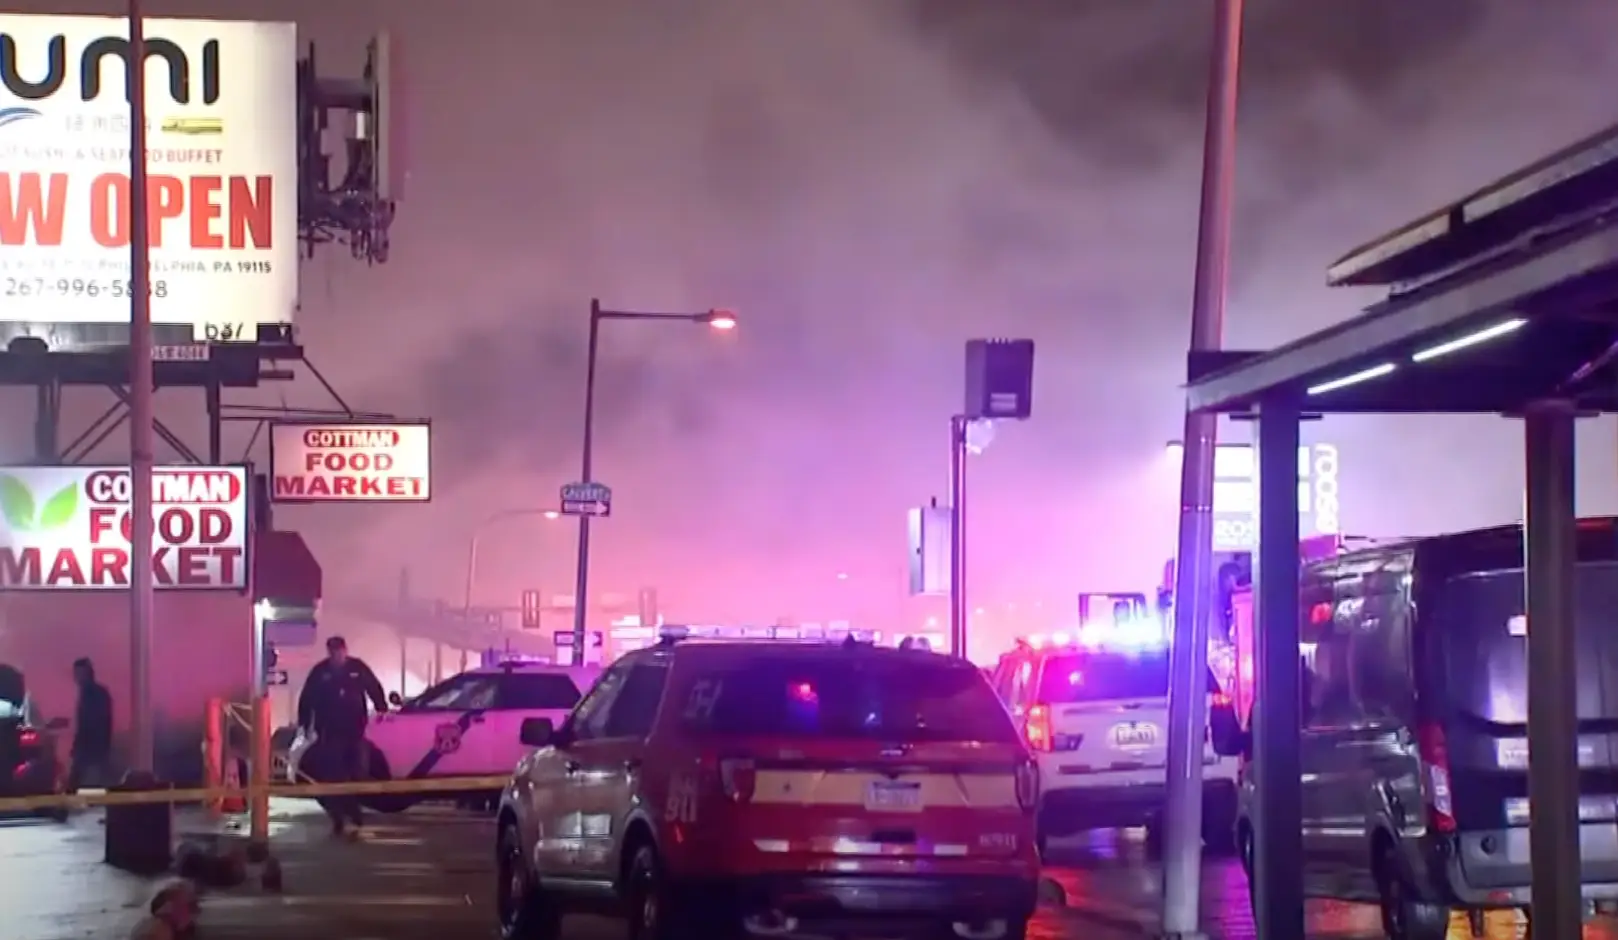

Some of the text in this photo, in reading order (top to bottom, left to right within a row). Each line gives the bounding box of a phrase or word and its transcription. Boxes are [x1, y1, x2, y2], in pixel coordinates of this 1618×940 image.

[166, 148, 223, 163] BUFFET
[90, 172, 273, 251] OPEN
[213, 262, 233, 274] PA
[238, 261, 272, 275] 19115
[5, 276, 168, 298] 267-996-58
[307, 430, 394, 447] COTTMAN
[305, 452, 393, 471] FOOD
[91, 472, 230, 501] COTMAN
[275, 476, 424, 496] MARKET
